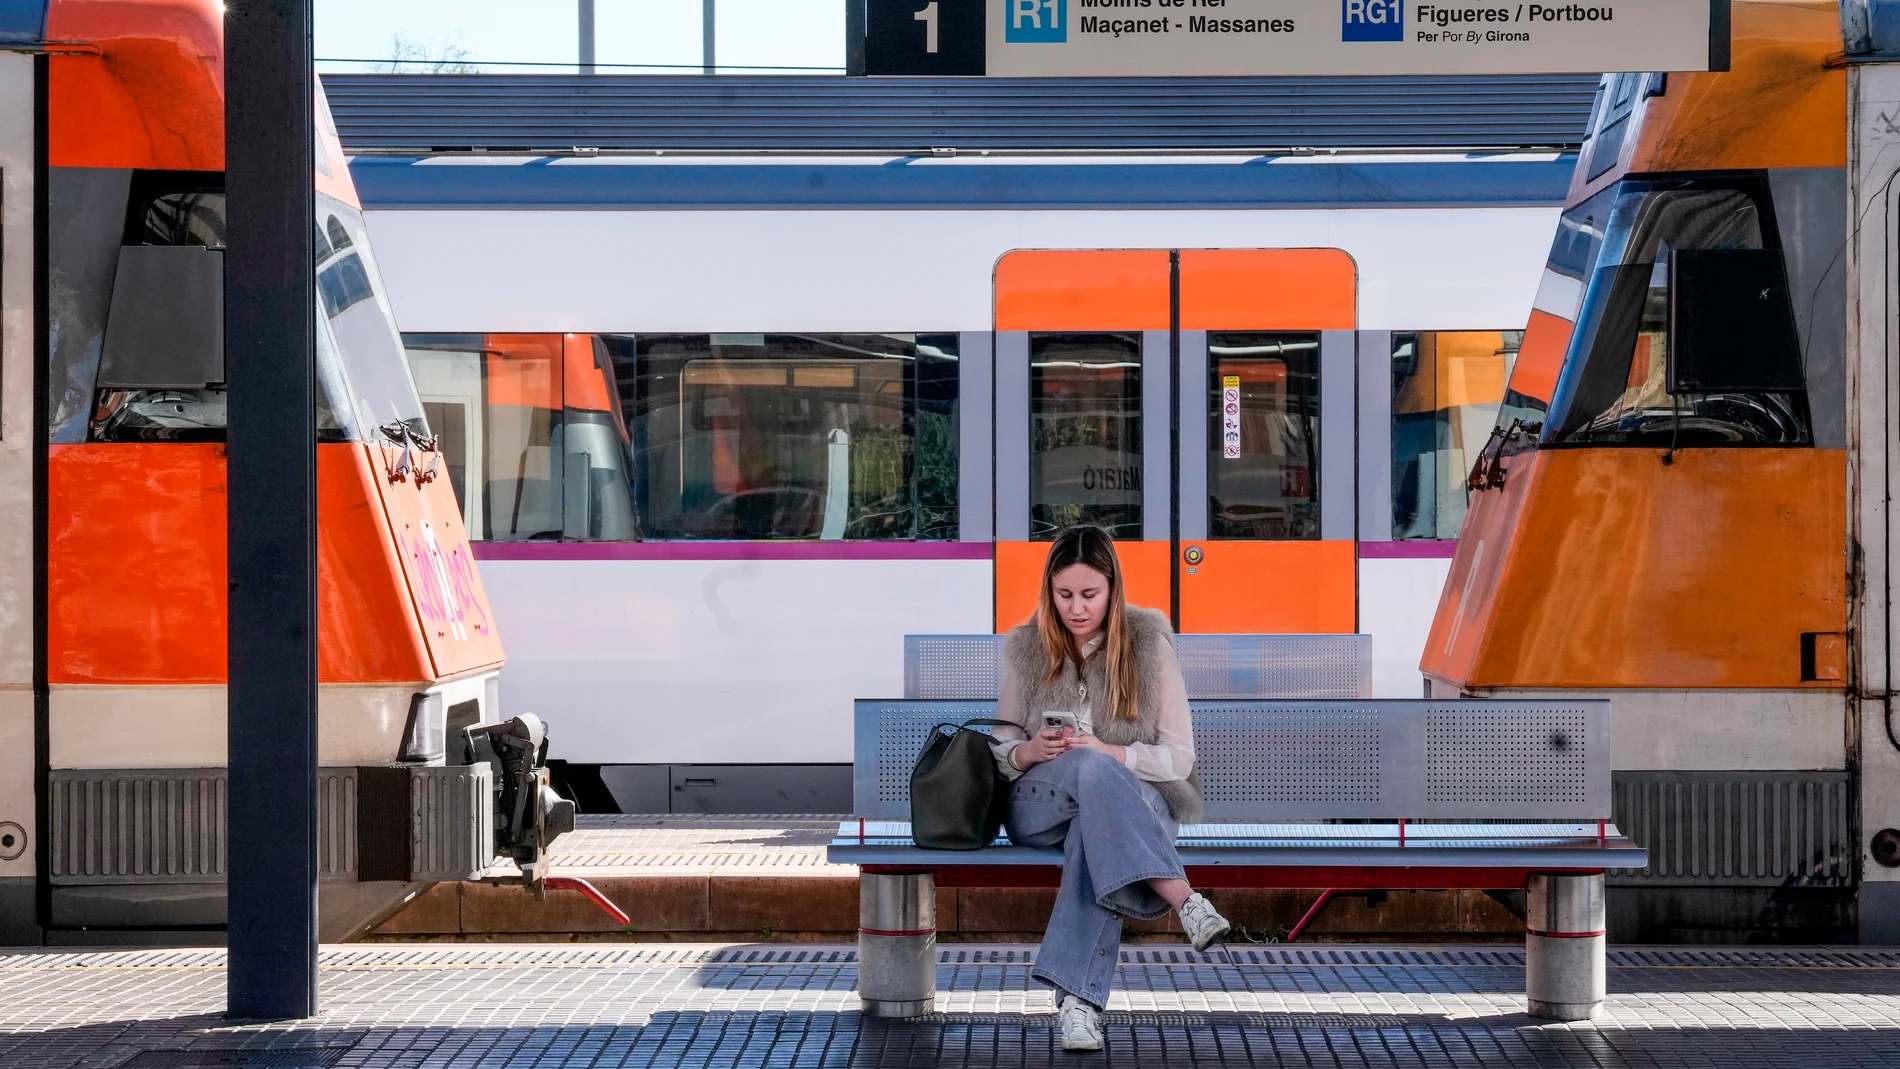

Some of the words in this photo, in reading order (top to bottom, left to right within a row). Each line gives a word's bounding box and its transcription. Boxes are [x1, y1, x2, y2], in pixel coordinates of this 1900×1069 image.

[1013, 0, 1058, 28] R1
[1346, 0, 1399, 24] RG1
[1417, 5, 1509, 27] Figueres
[1529, 4, 1613, 22] Portbou
[914, 2, 938, 53] 1
[1080, 16, 1170, 38] Maçanet
[1189, 16, 1295, 33] Massanes
[1417, 31, 1438, 42] Per
[1442, 31, 1463, 42] Por
[1466, 31, 1483, 45] By
[1486, 30, 1530, 42] Girona
